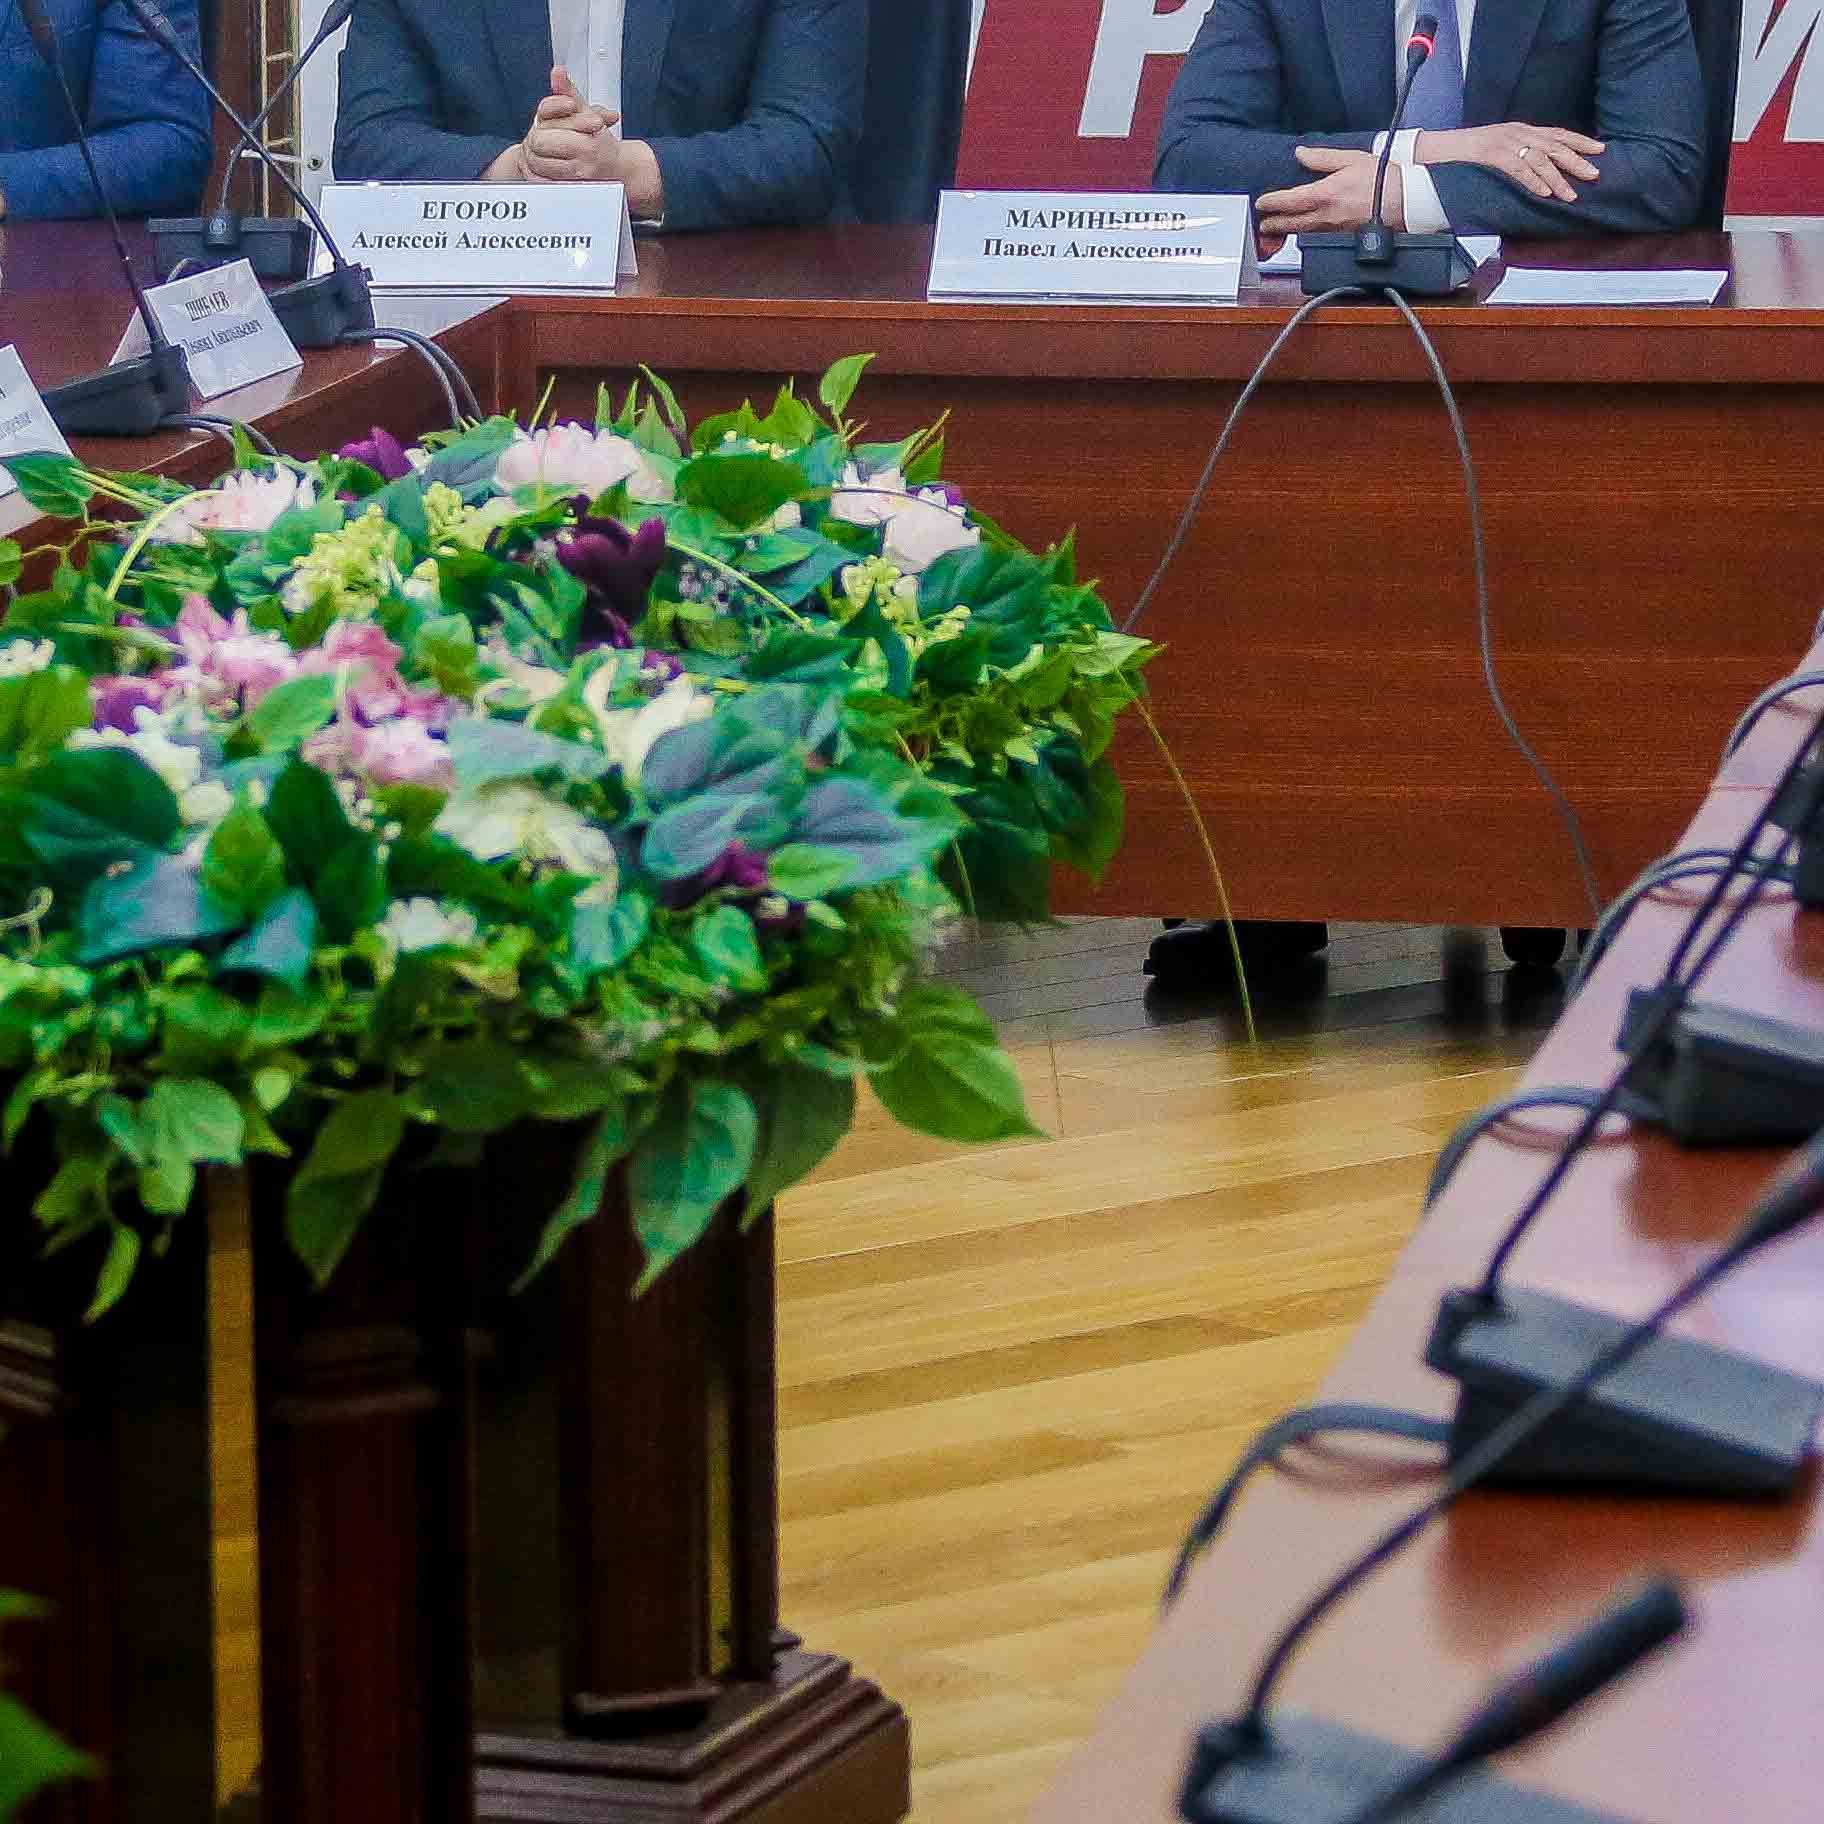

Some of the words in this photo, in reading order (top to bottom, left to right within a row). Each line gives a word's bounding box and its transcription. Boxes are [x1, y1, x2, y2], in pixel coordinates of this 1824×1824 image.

[422, 200, 528, 220] ЕГОРОВ
[352, 231, 448, 249] Алексей
[455, 231, 592, 249] Алексеевич
[983, 238, 1055, 257] Павел
[1064, 240, 1202, 258] Алексеевич
